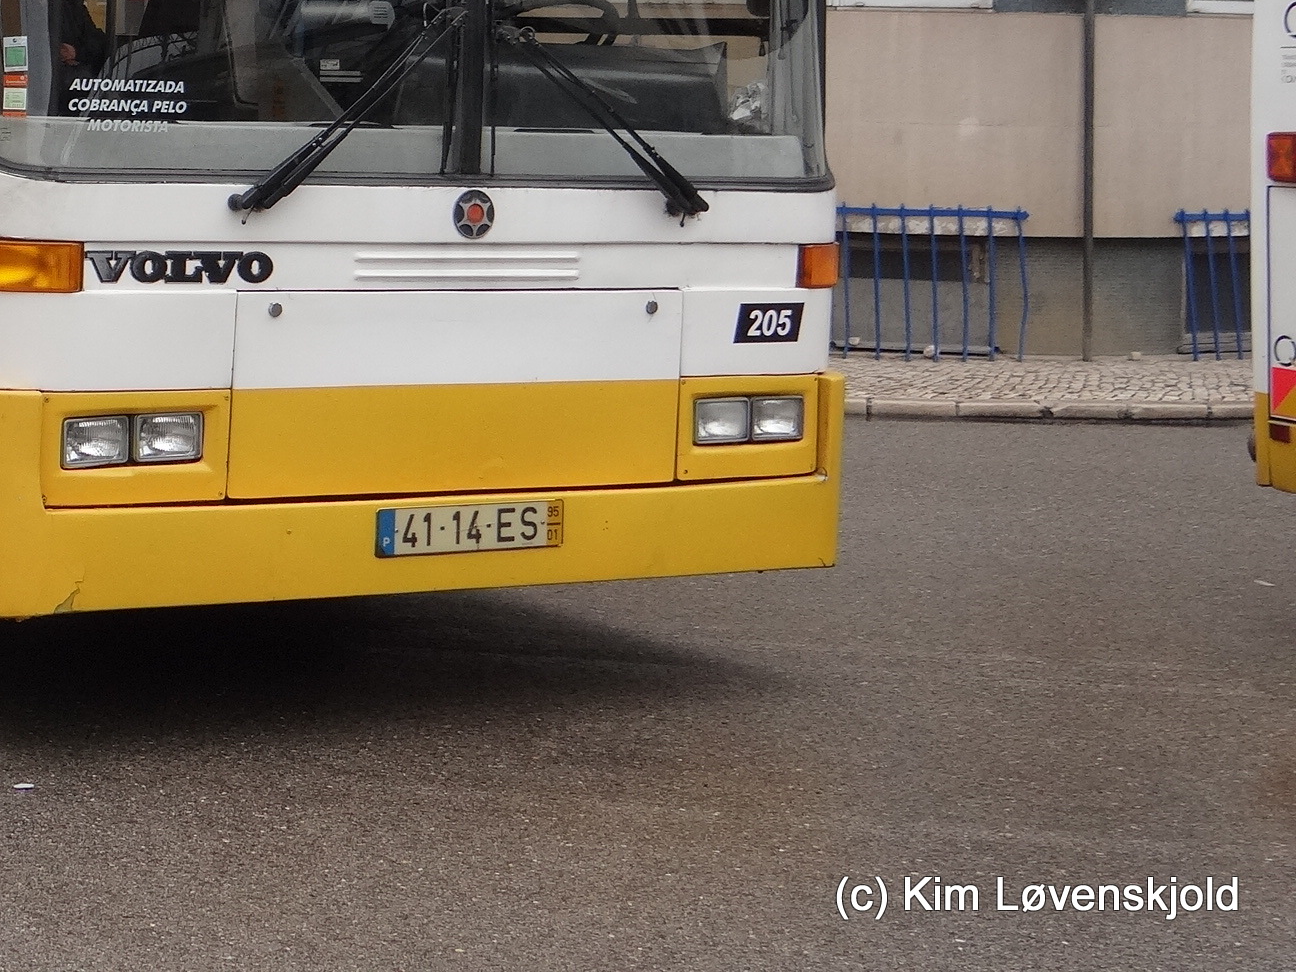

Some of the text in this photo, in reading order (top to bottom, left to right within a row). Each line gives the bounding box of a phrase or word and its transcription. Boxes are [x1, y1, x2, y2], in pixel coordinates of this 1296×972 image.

[68, 78, 186, 94] AUTOMATIZADA
[67, 98, 188, 116] COBRANÇA PELO
[86, 119, 169, 133] MOTORISTA
[84, 250, 275, 284] VOLVO
[746, 309, 793, 337] 205
[546, 505, 560, 518] 95
[546, 528, 559, 541] 01
